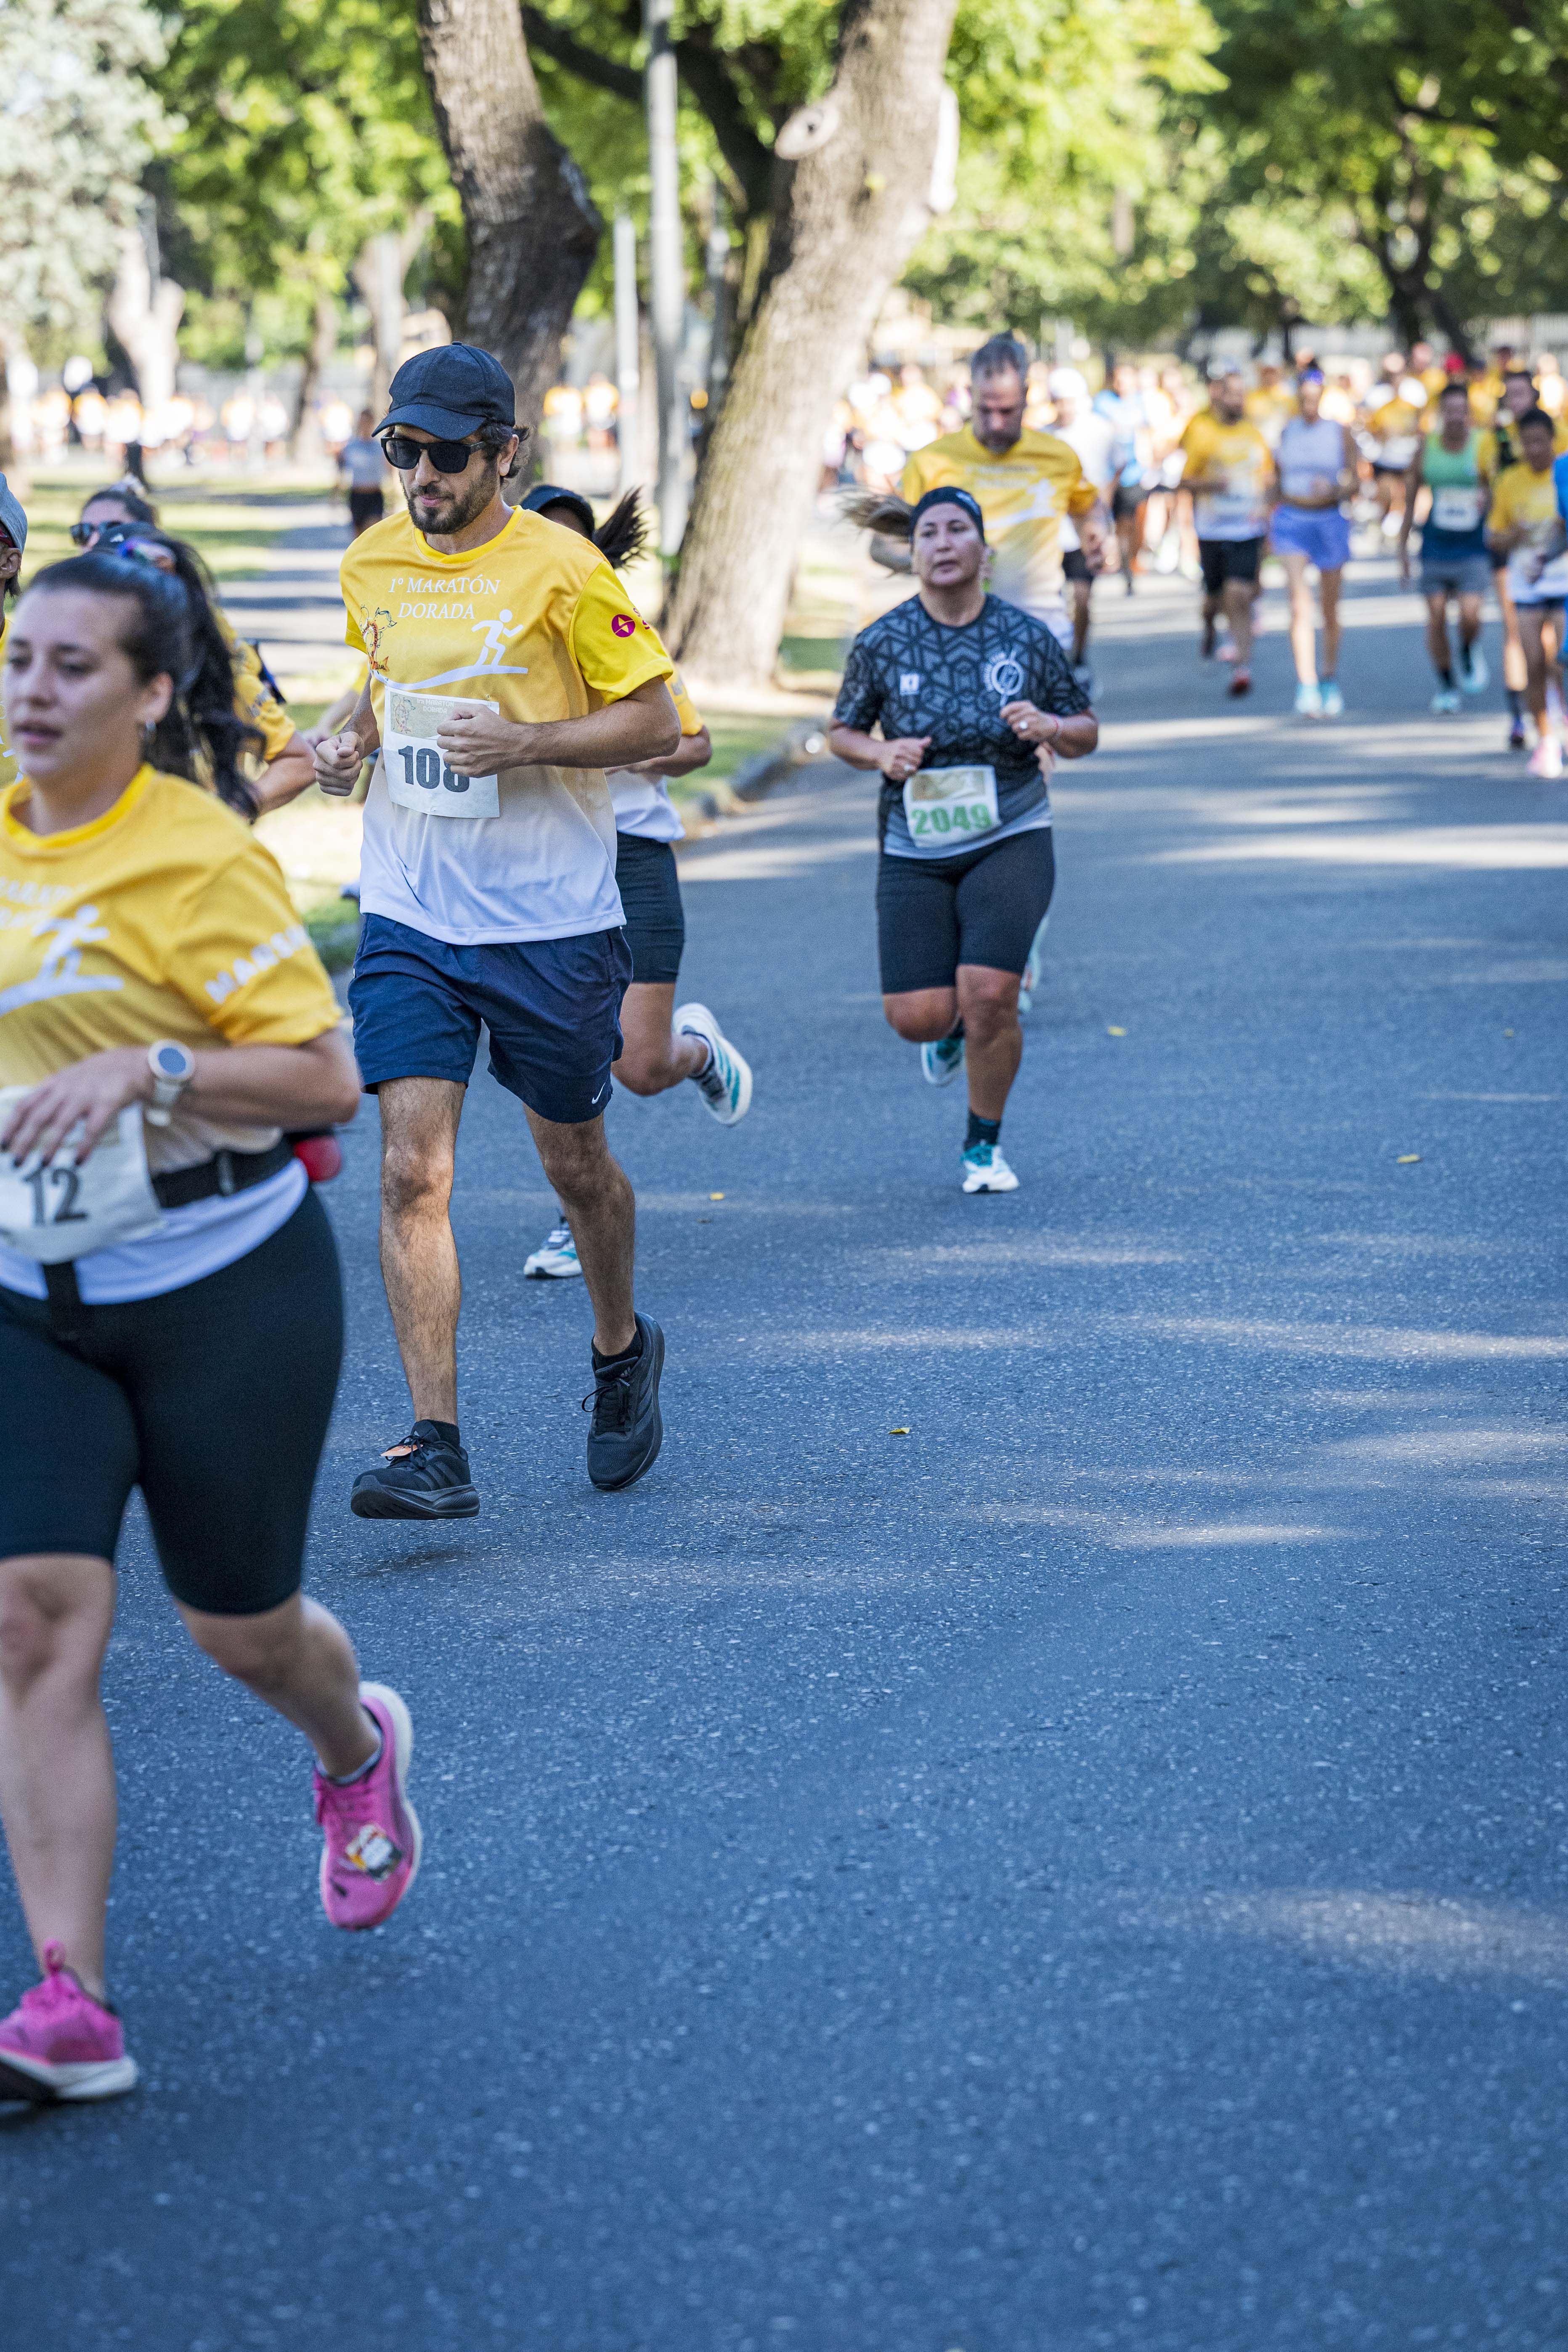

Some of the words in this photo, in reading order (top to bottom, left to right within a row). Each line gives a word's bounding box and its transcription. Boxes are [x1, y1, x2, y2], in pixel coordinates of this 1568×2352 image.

[406, 574, 501, 595] MARATÓN
[397, 603, 475, 619] DORADA
[423, 706, 447, 714] DORADA
[910, 803, 992, 835] 2049
